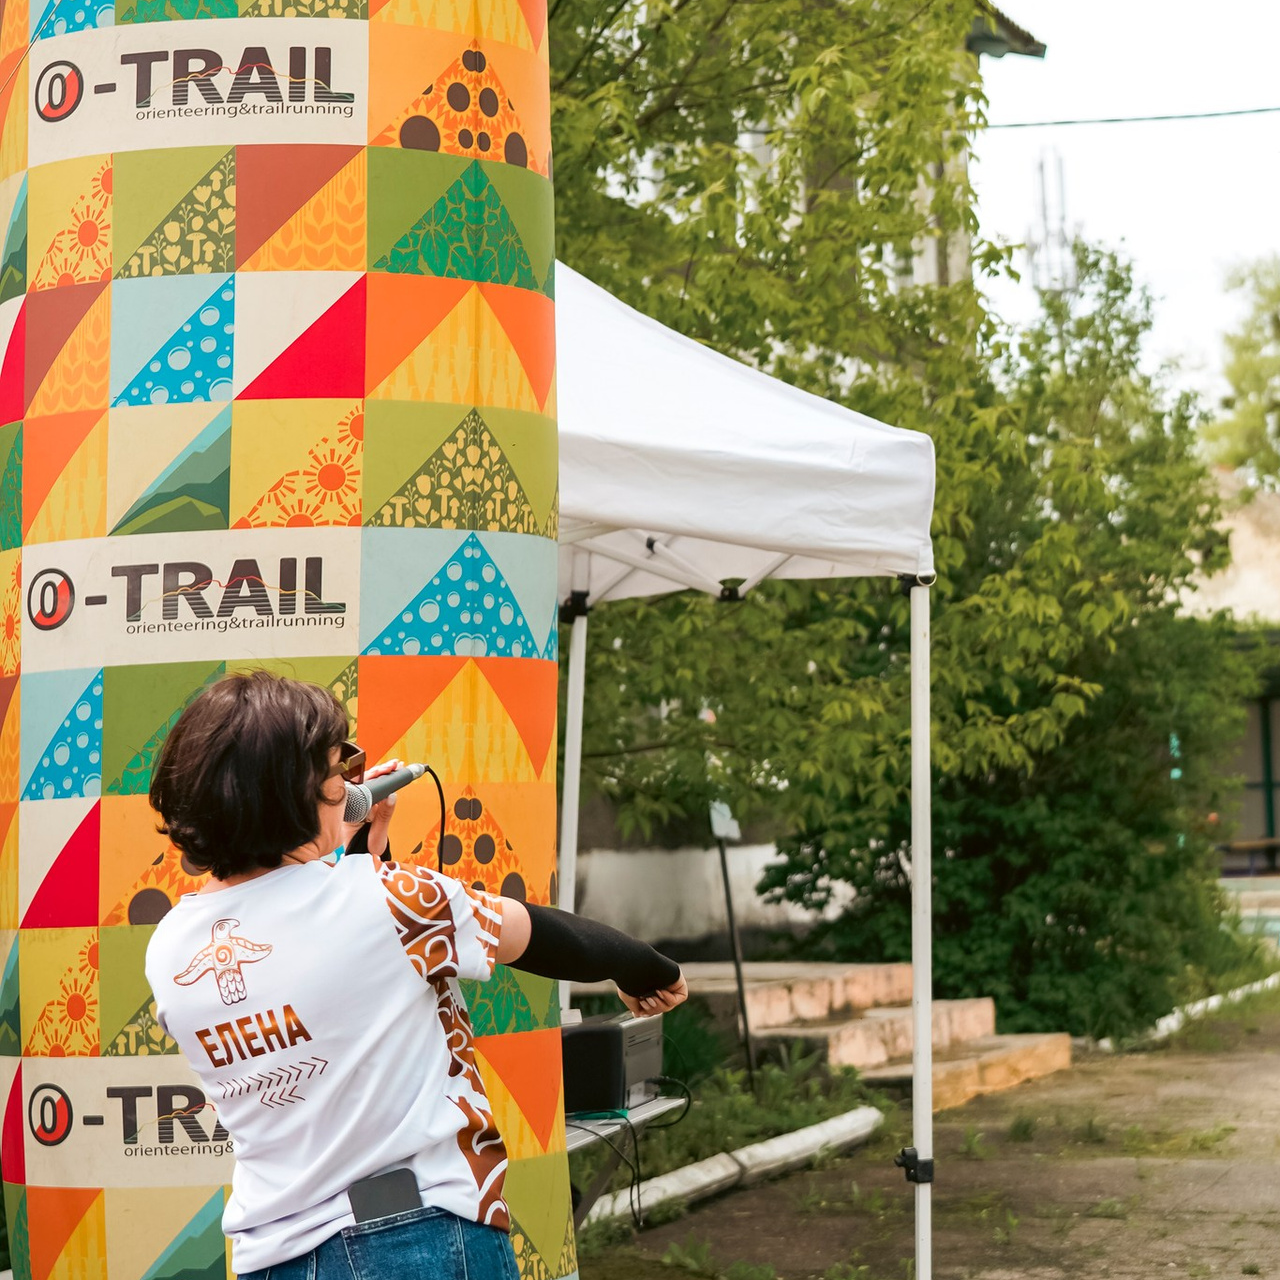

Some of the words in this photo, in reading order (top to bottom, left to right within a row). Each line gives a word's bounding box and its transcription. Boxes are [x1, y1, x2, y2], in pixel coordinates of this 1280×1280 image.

[135, 102, 355, 121] orienteering&trailrunning
[126, 614, 346, 635] orienteering&trailrunning
[195, 1004, 313, 1069] ЕЛЕНА
